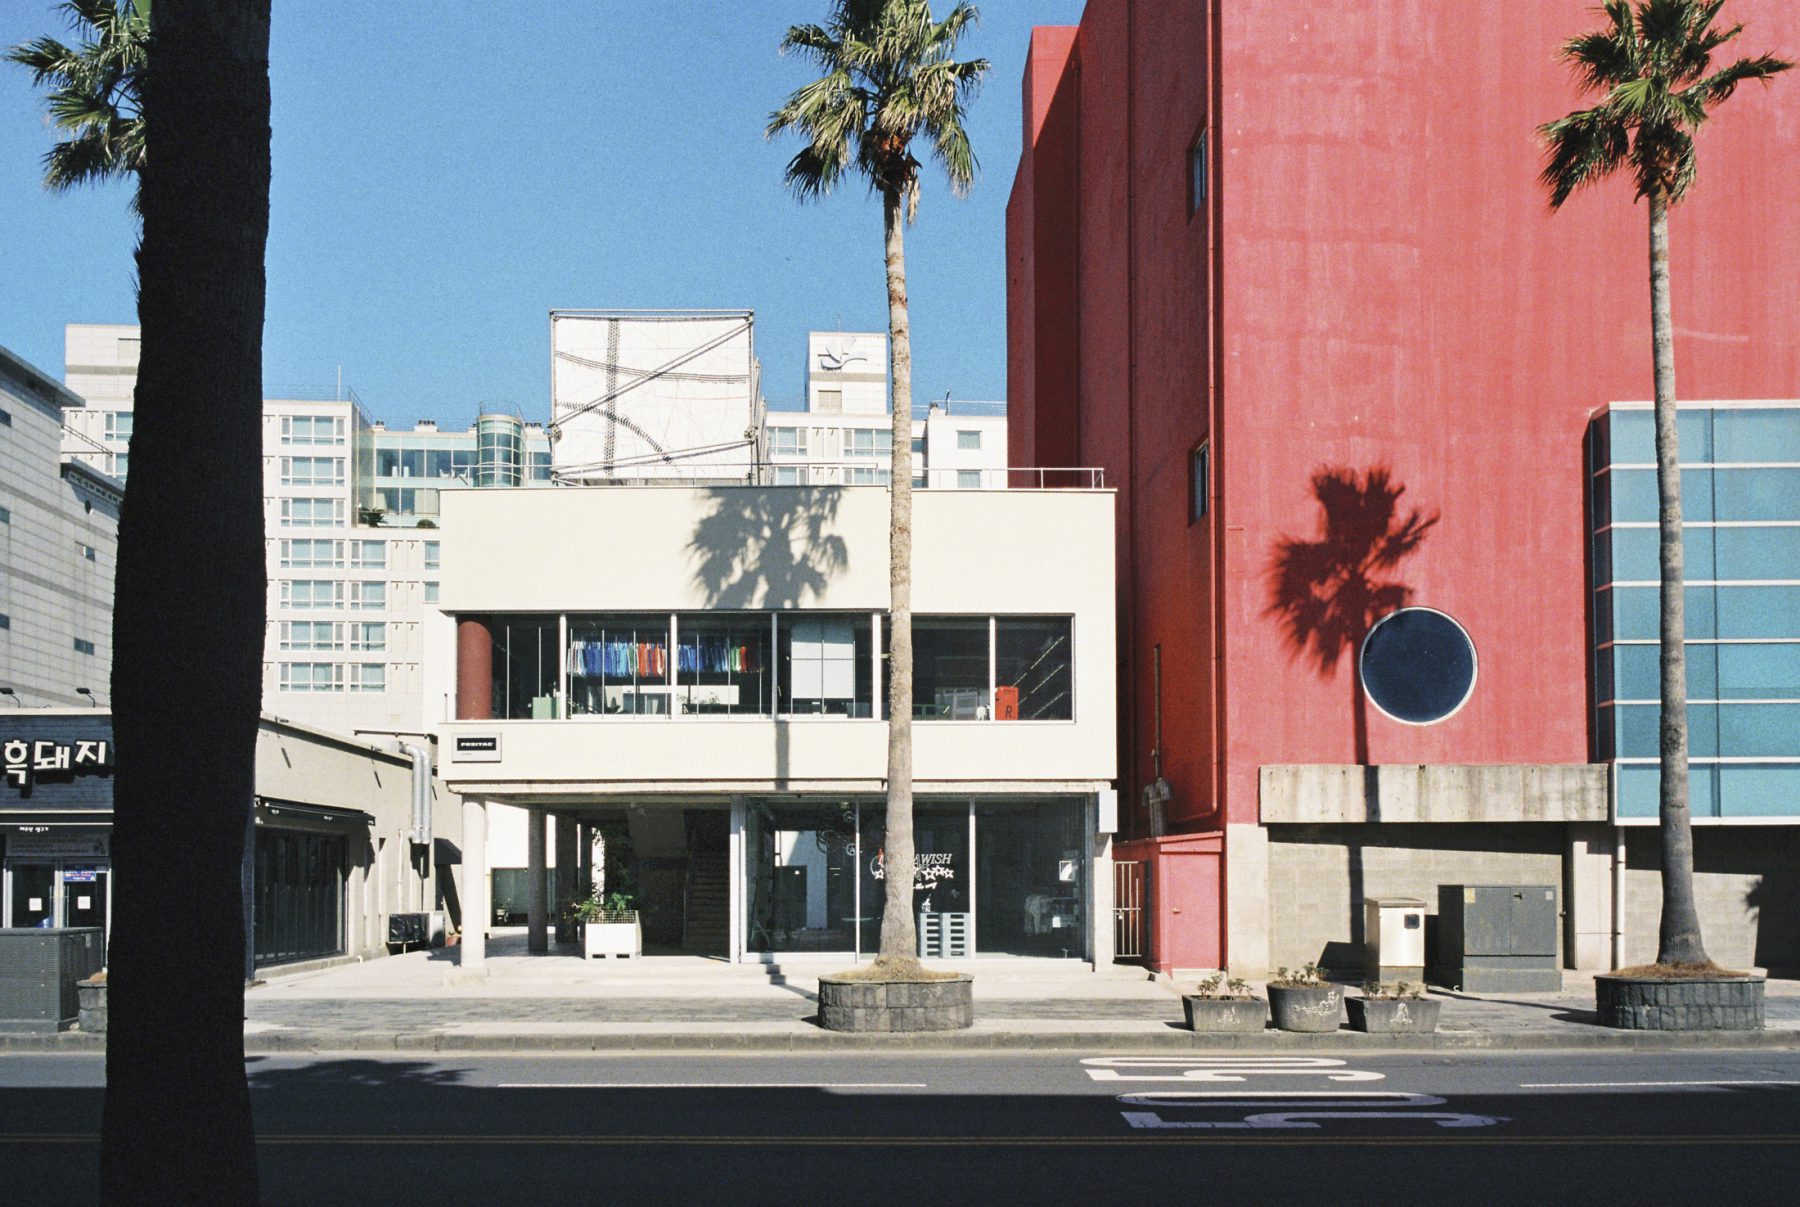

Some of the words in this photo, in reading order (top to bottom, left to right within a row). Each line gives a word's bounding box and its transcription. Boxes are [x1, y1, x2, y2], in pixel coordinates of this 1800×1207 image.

[4, 739, 107, 785] 흑돼지
[921, 853, 952, 864] WISH
[1079, 1056, 1386, 1082] 50
[1115, 1091, 1513, 1129] 50
